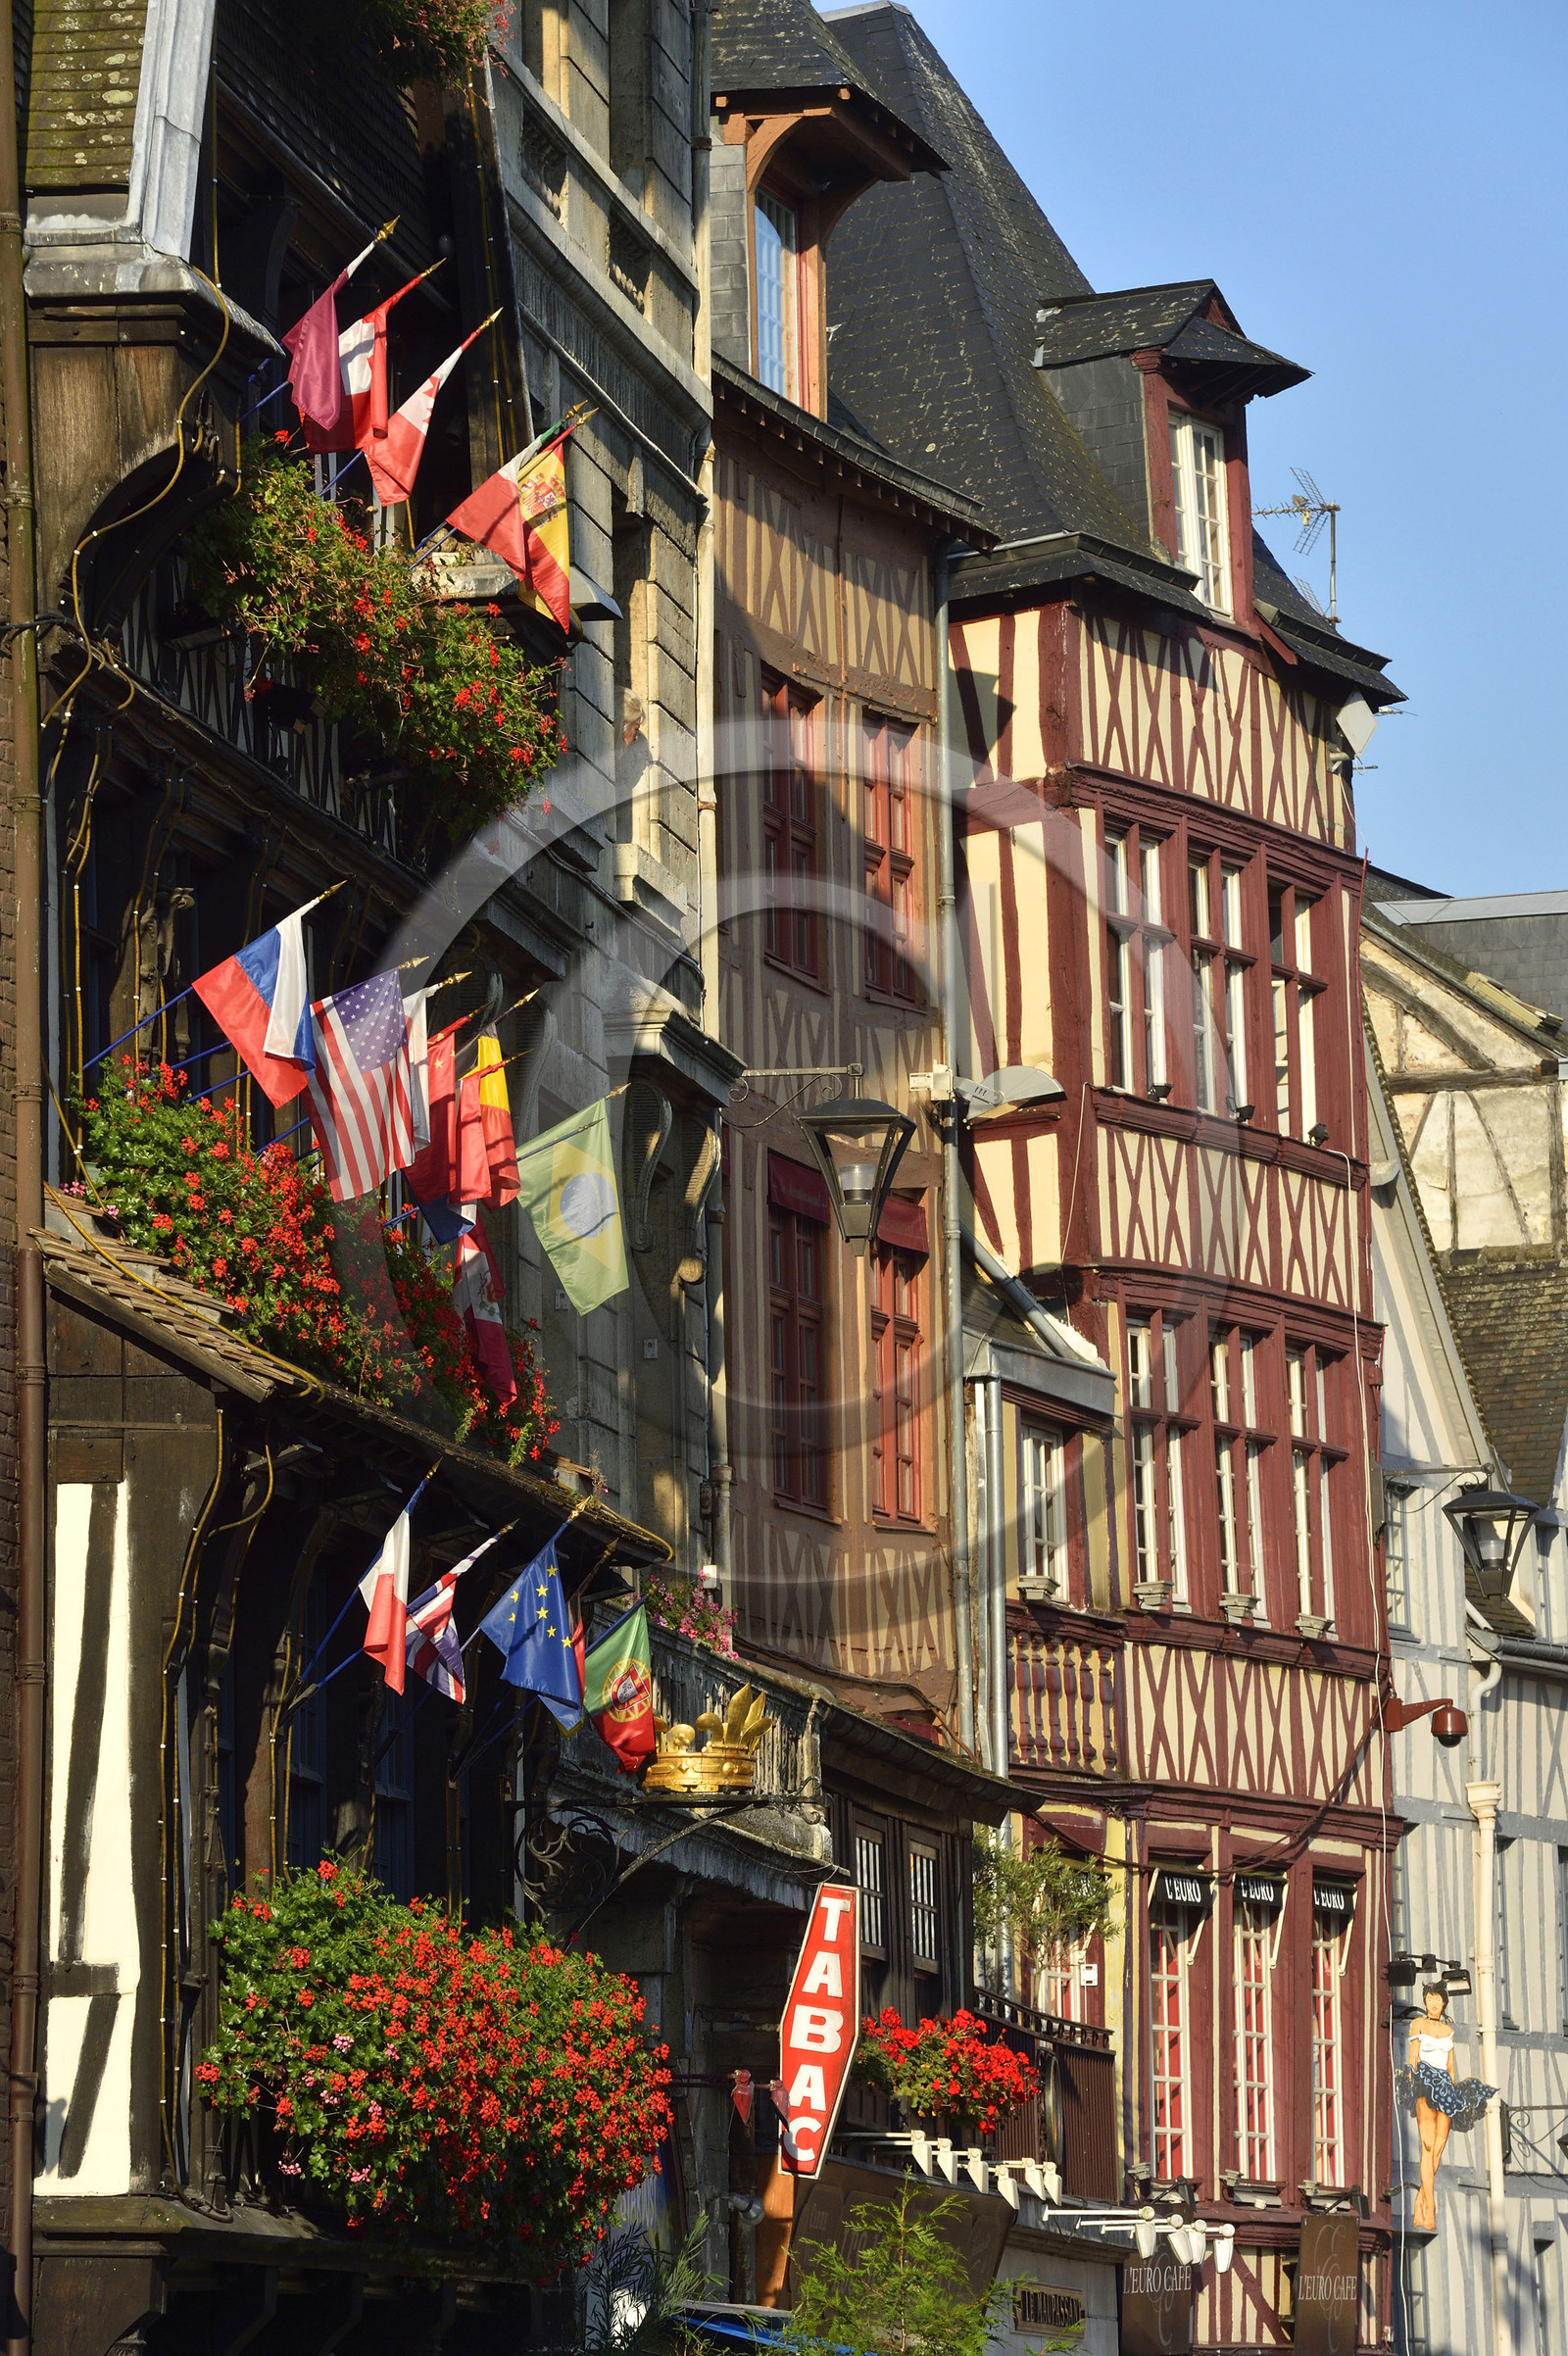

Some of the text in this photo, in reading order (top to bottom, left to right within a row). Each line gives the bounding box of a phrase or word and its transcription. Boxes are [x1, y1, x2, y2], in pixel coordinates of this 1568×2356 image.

[1164, 1876, 1201, 1903] L'EURO
[1241, 1877, 1274, 1902] L'EURO
[1313, 1885, 1345, 1910] L'EURO
[785, 1896, 851, 2161] TABAC
[1122, 2265, 1192, 2294] L'EURO CAFE
[1298, 2274, 1357, 2300] L'EURO CAFE
[1021, 2290, 1035, 2322] LE
